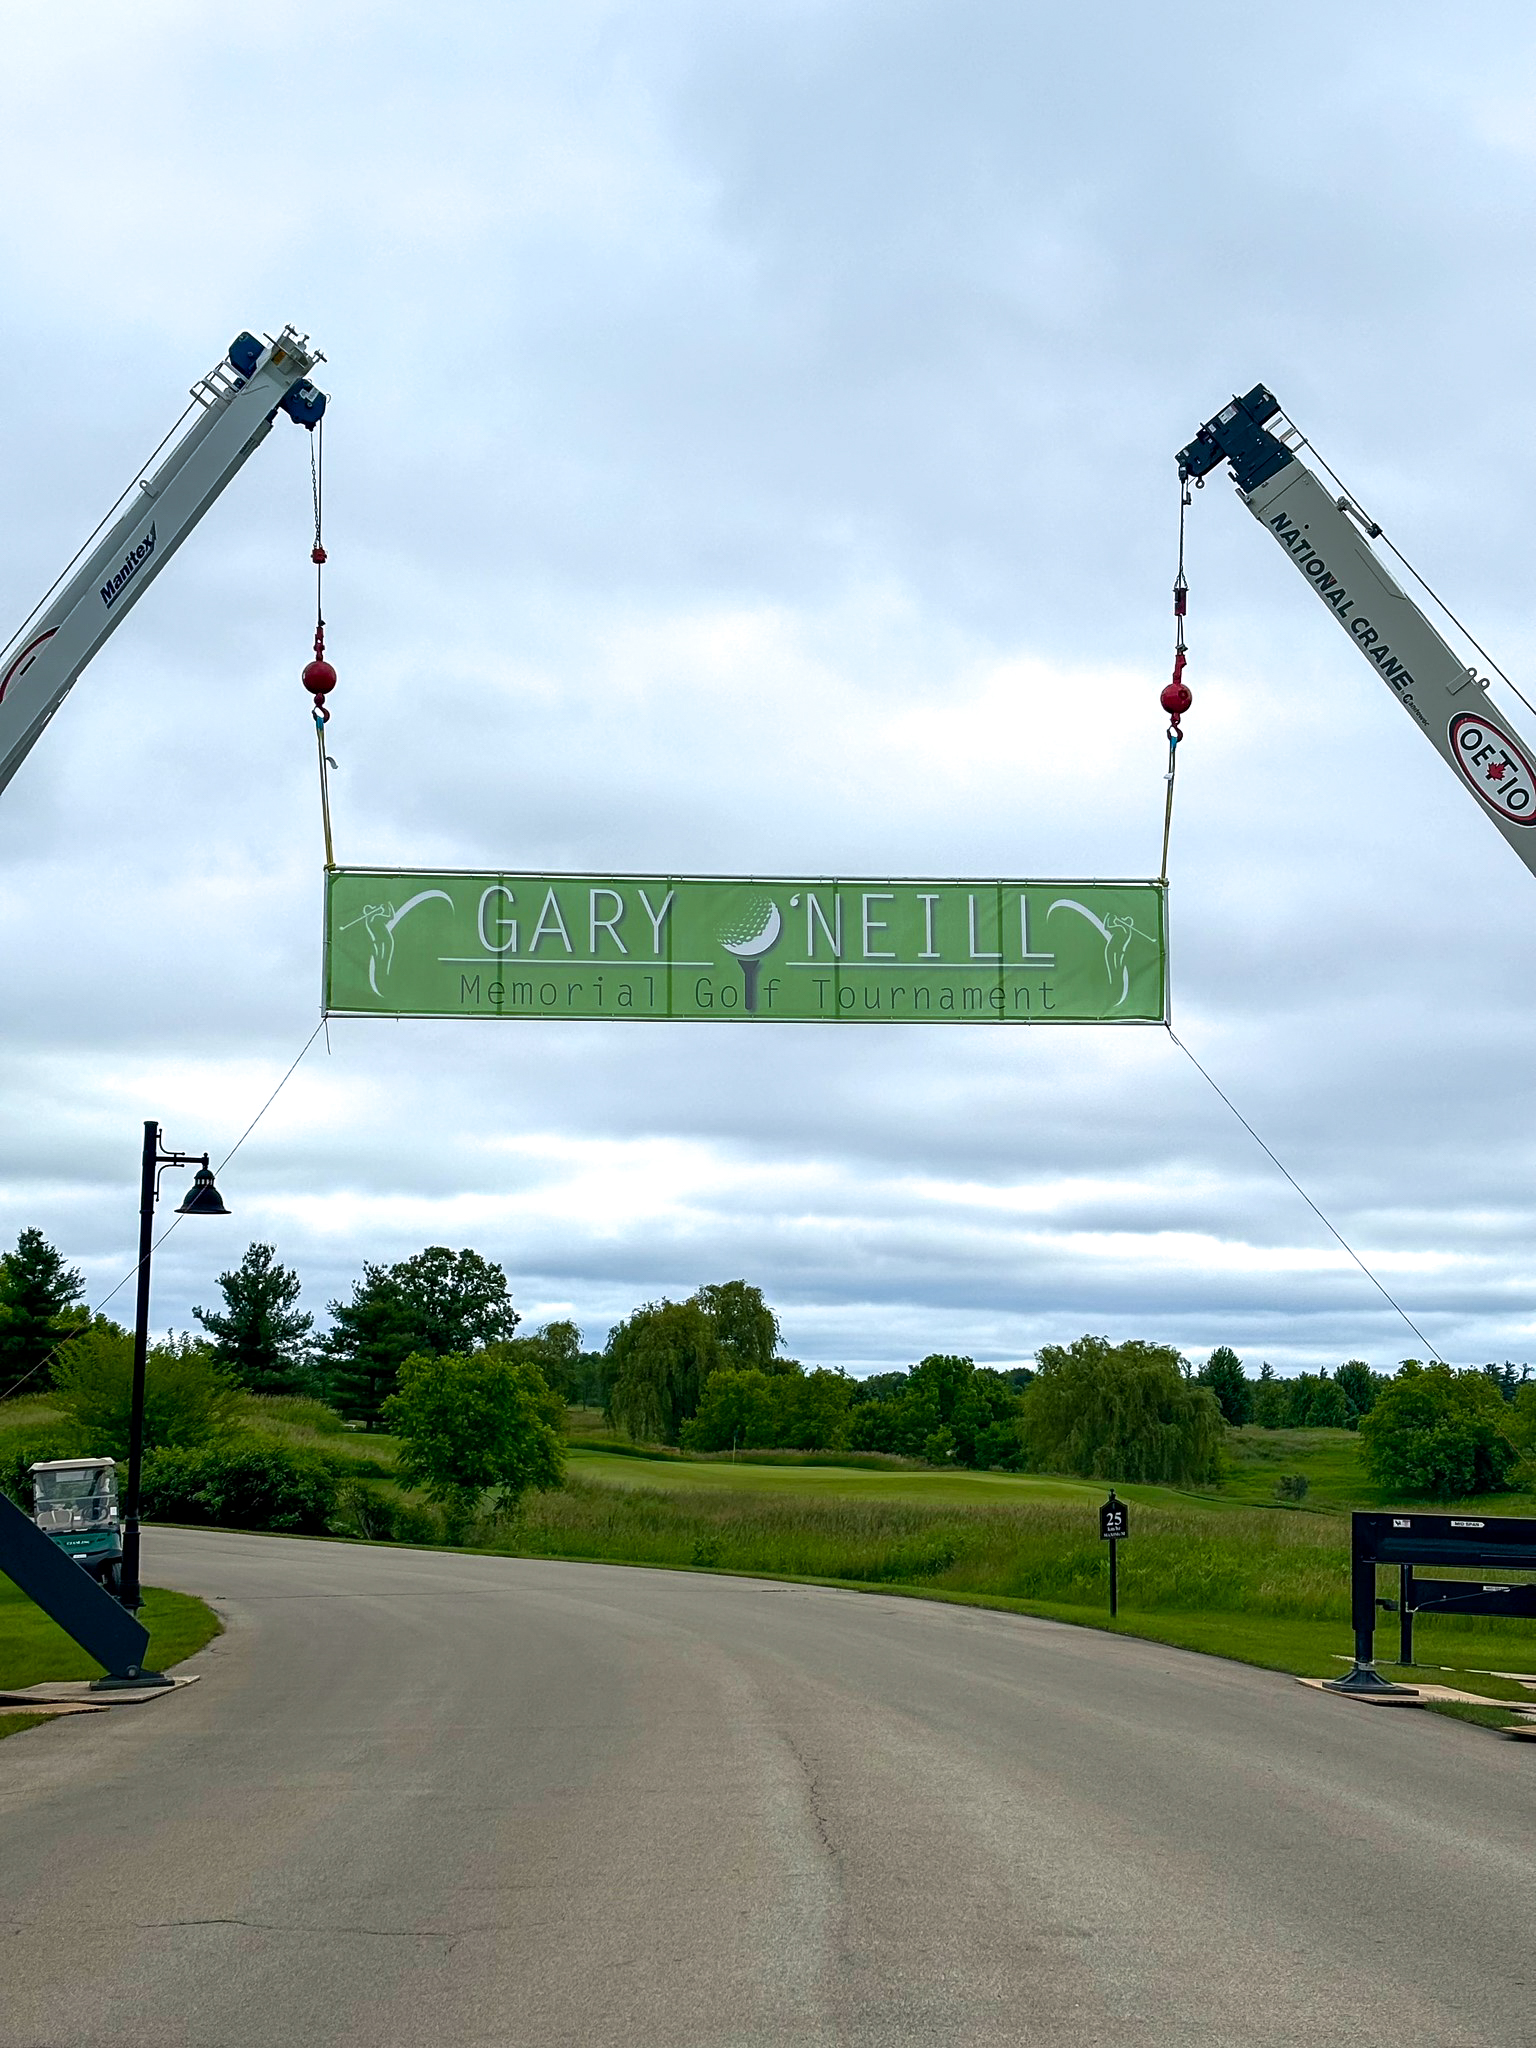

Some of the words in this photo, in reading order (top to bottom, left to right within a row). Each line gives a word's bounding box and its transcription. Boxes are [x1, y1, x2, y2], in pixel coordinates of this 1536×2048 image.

[100, 531, 156, 604] Manitex
[1270, 512, 1354, 618] NATIONAL
[1351, 617, 1414, 691] CRANE
[477, 885, 675, 954] GARY
[461, 974, 655, 1007] Memorial
[812, 979, 1056, 1010] Tournament
[1106, 1512, 1122, 1526] 25
